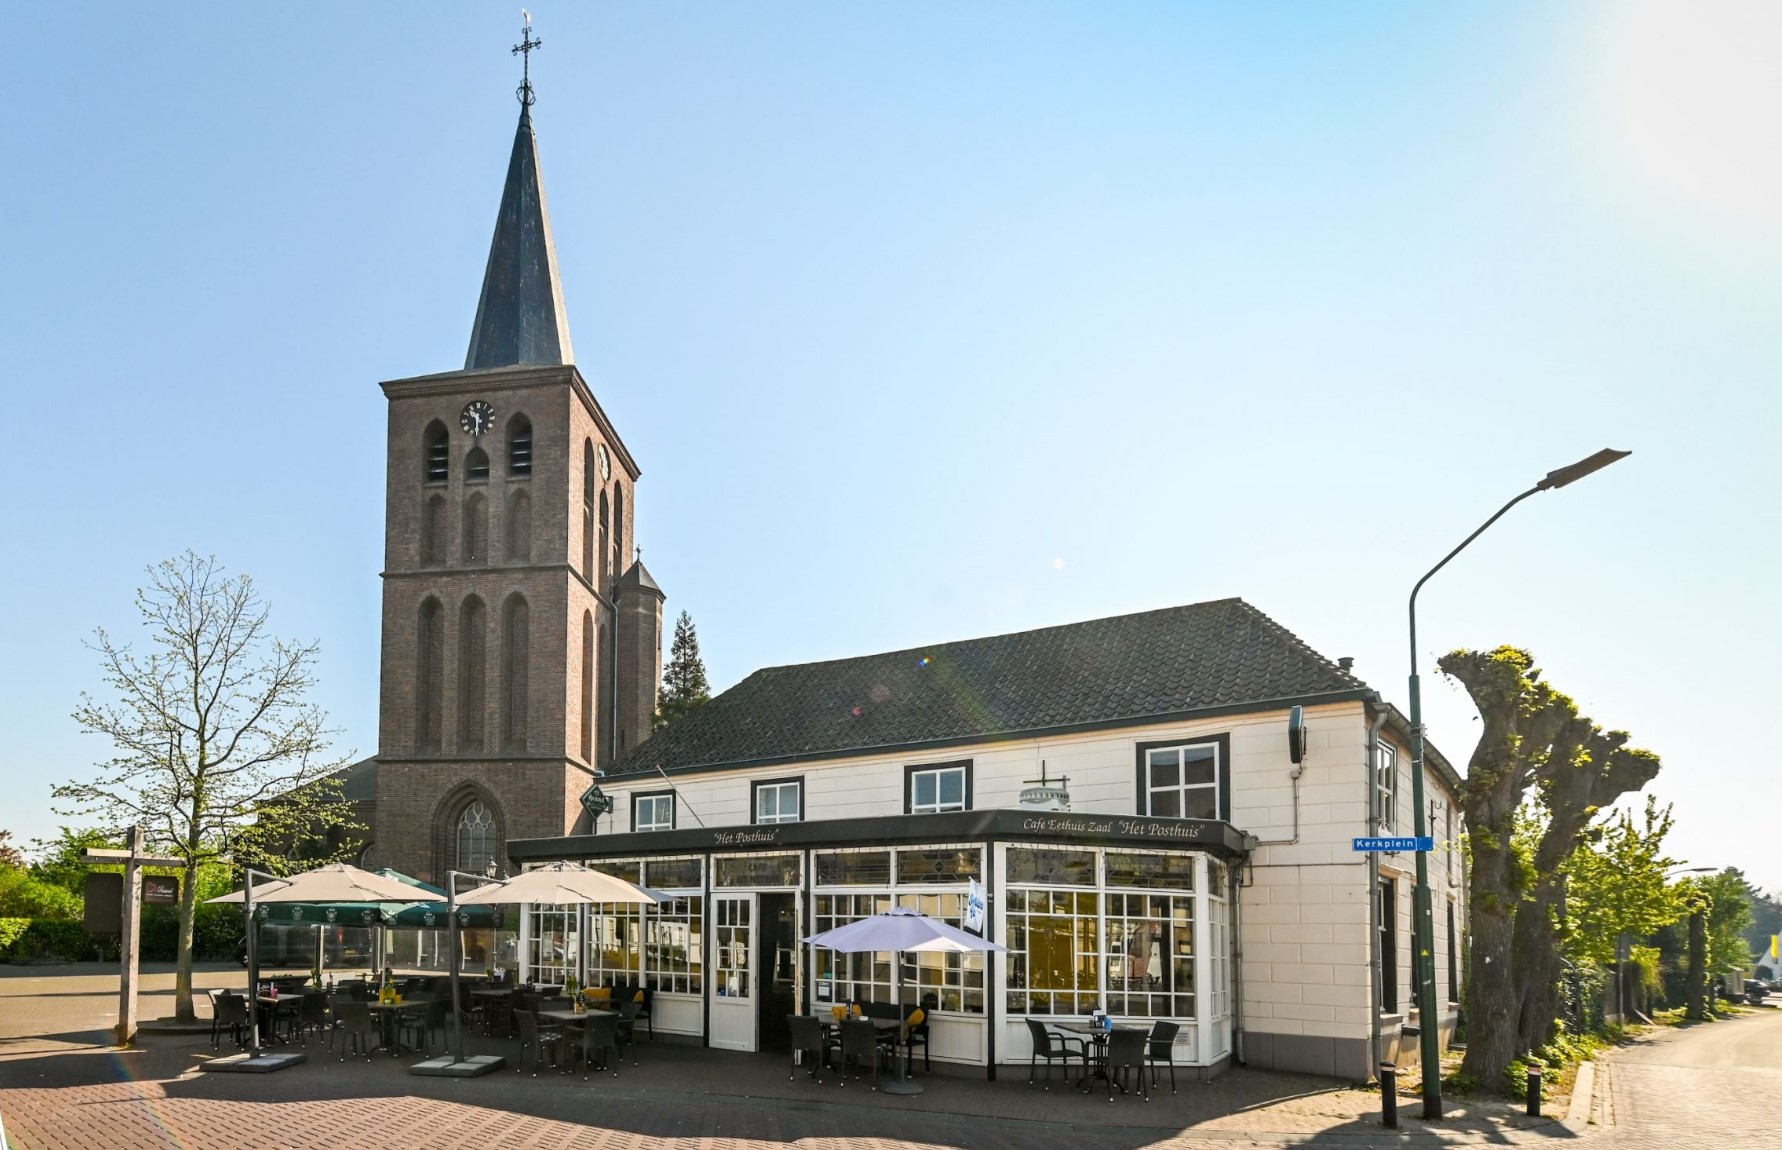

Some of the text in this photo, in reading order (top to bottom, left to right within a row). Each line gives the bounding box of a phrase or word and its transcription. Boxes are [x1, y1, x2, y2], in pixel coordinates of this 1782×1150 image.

[714, 828, 779, 844] “Het Posthuis”
[1047, 819, 1086, 832] Eethuis
[1087, 821, 1113, 833] Zaal
[1119, 820, 1145, 835] “Het
[1148, 823, 1205, 838] Posthuis”
[1356, 840, 1413, 848] Kerkplein
